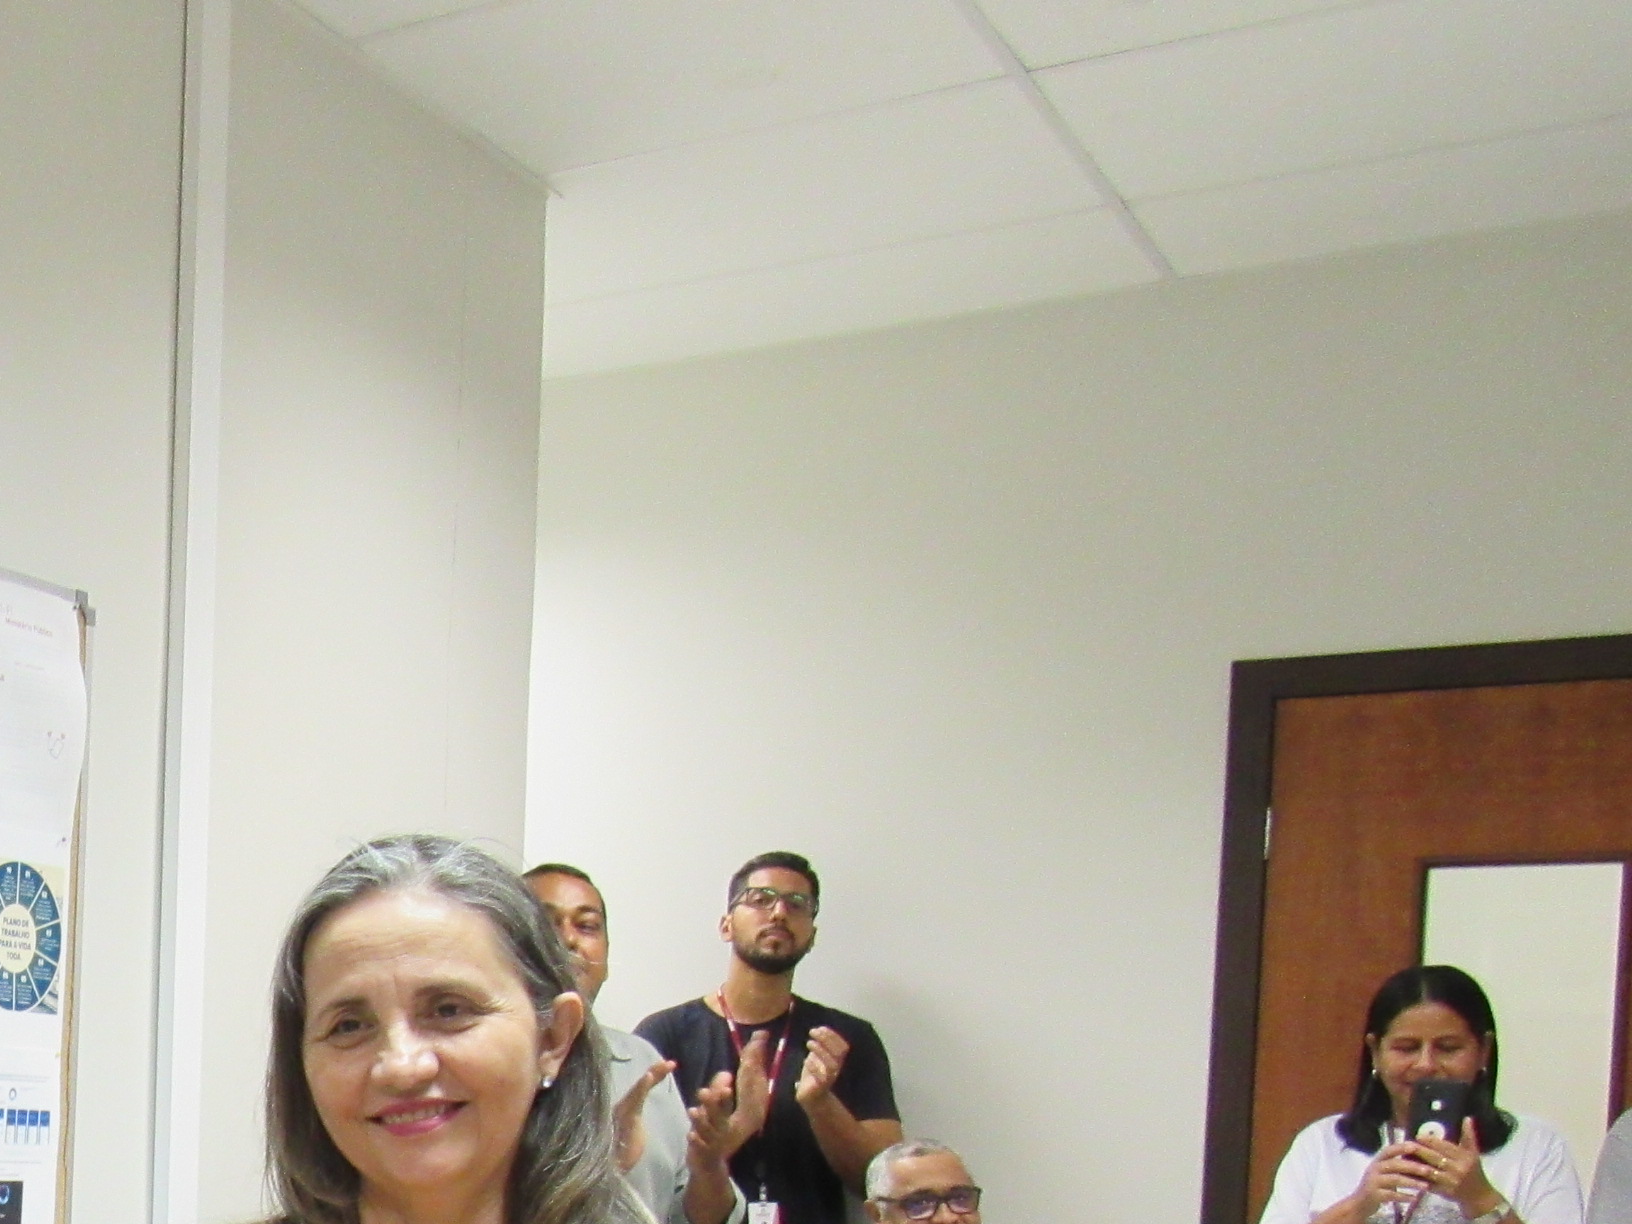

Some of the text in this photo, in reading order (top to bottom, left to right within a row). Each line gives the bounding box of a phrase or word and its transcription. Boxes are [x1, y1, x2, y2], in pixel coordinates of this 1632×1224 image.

[3, 917, 21, 927] PLANO
[1, 928, 30, 939] TRABALHO
[18, 942, 31, 950] VIDA
